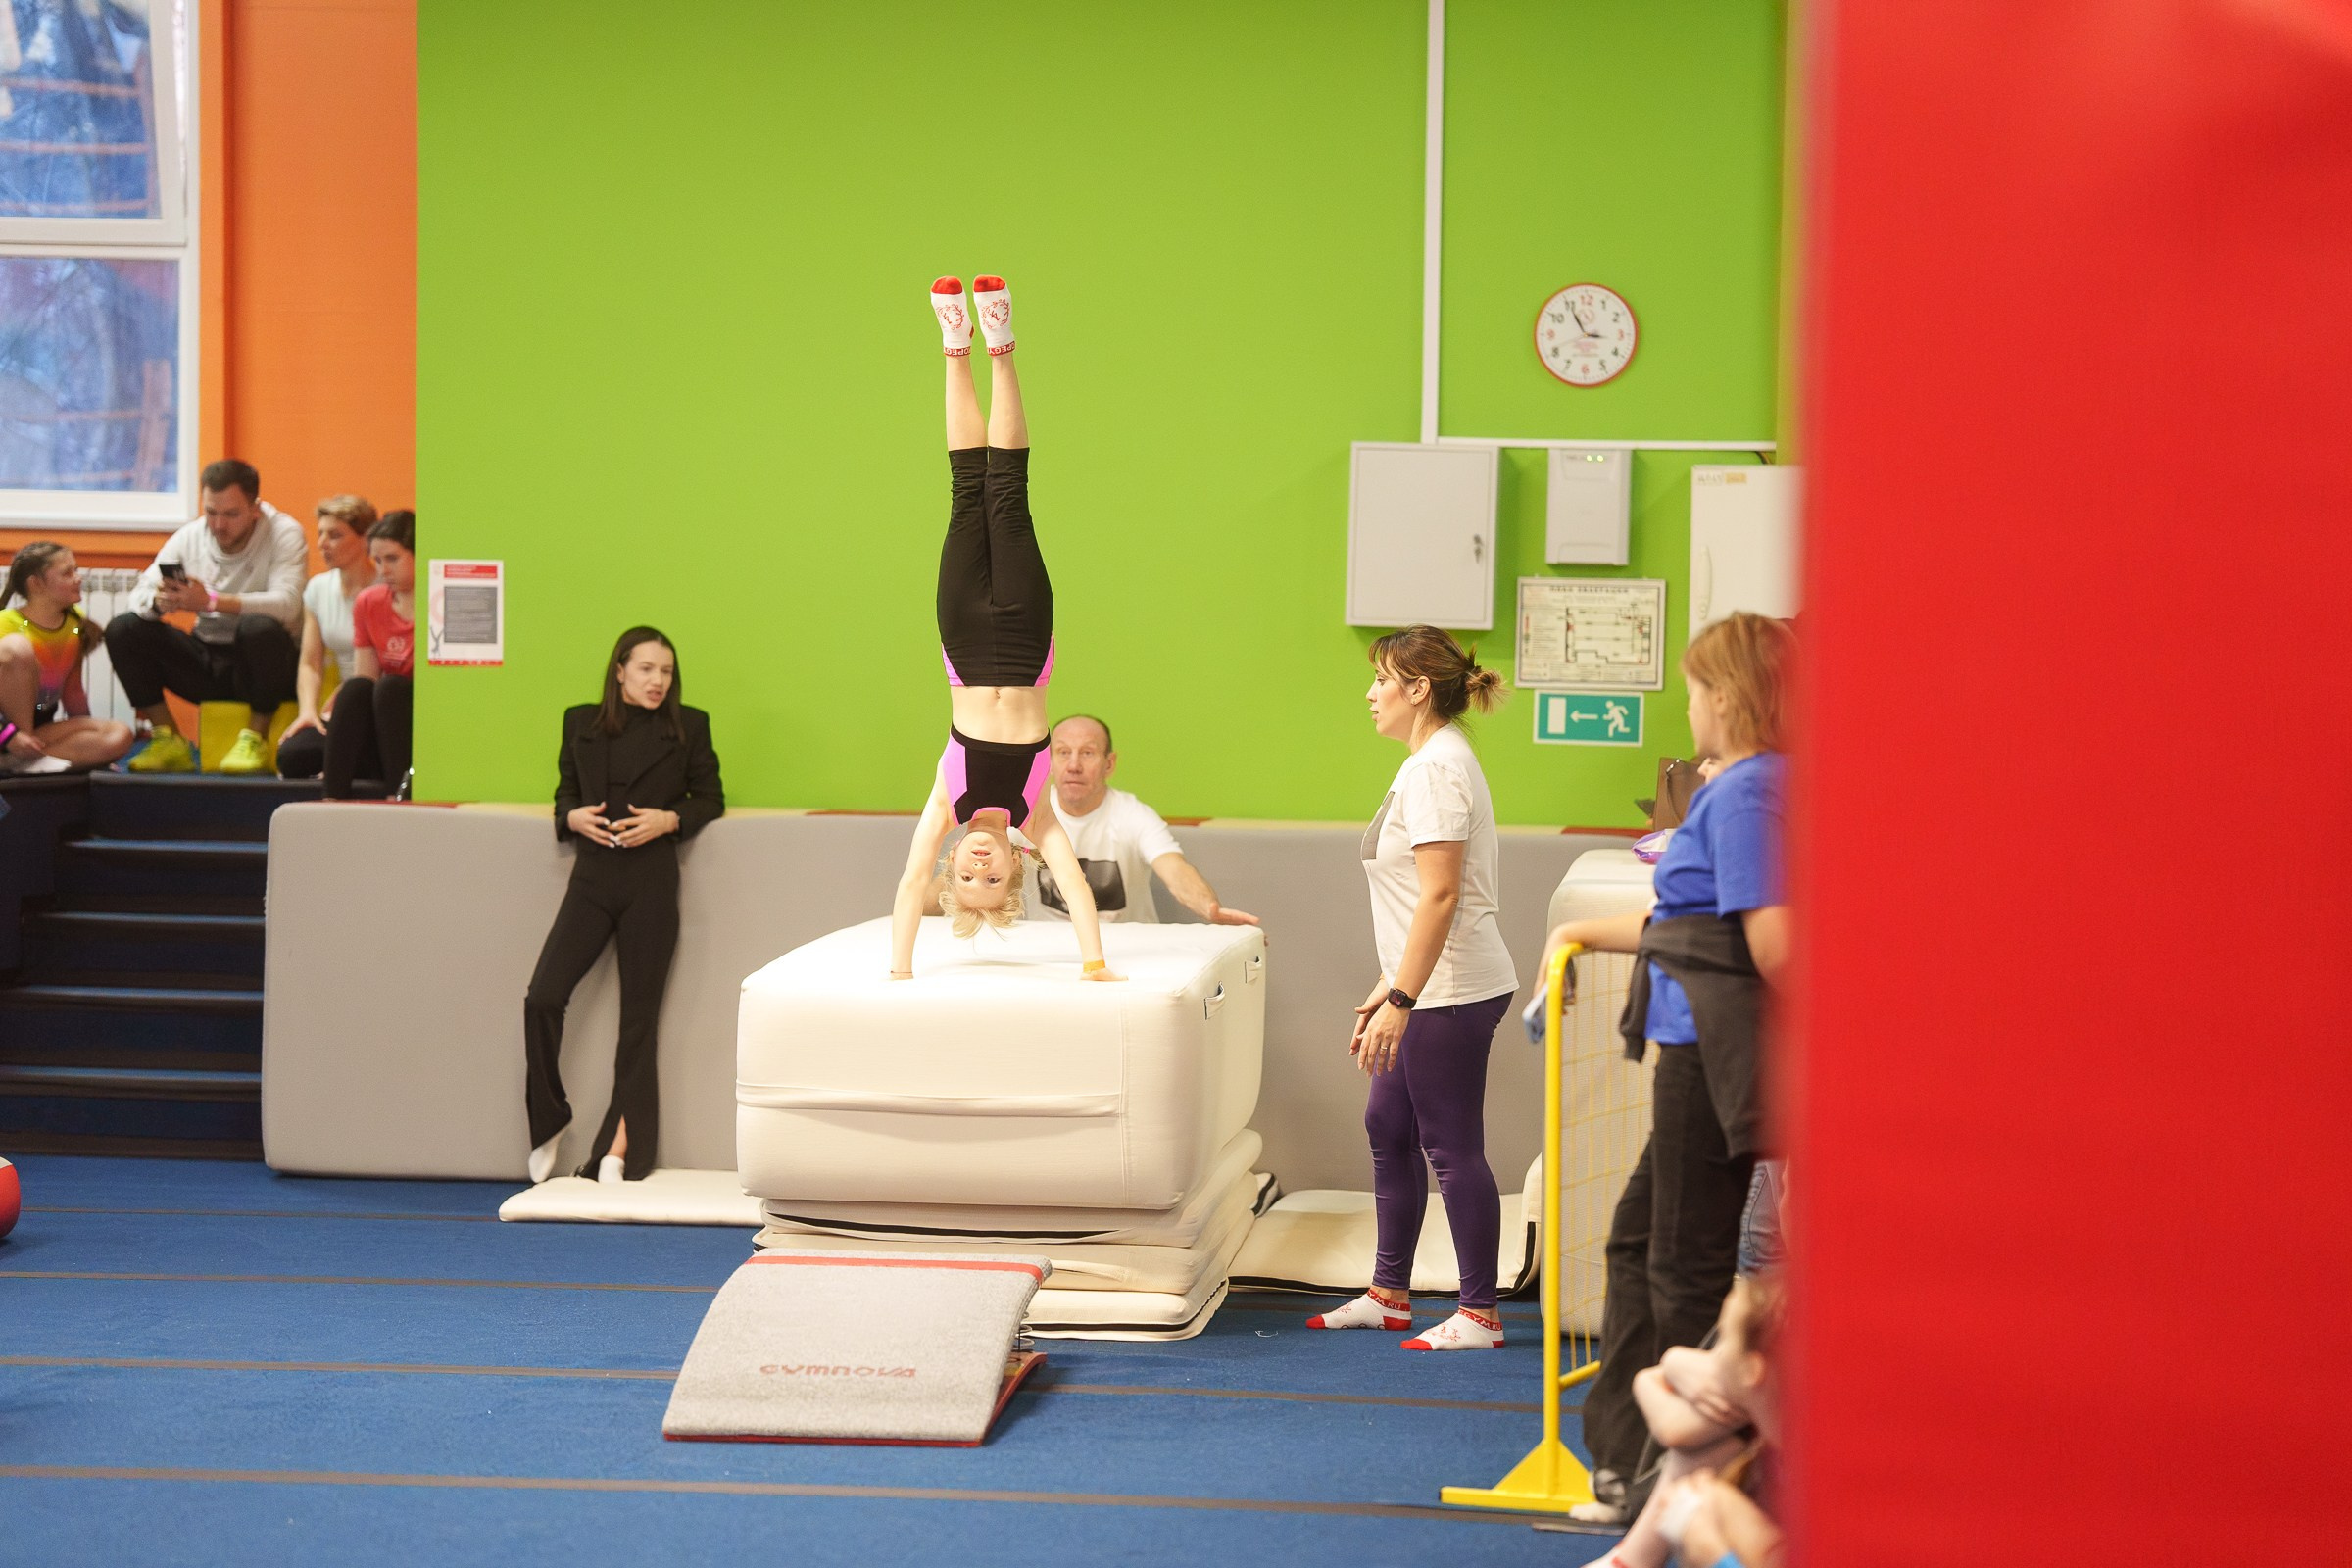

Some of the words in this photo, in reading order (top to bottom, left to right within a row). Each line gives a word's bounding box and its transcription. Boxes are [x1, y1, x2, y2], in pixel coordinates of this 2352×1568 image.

[1579, 294, 1593, 306] 12
[1600, 299, 1606, 310] 1
[1551, 313, 1564, 323] 10
[1612, 312, 1620, 323] 2
